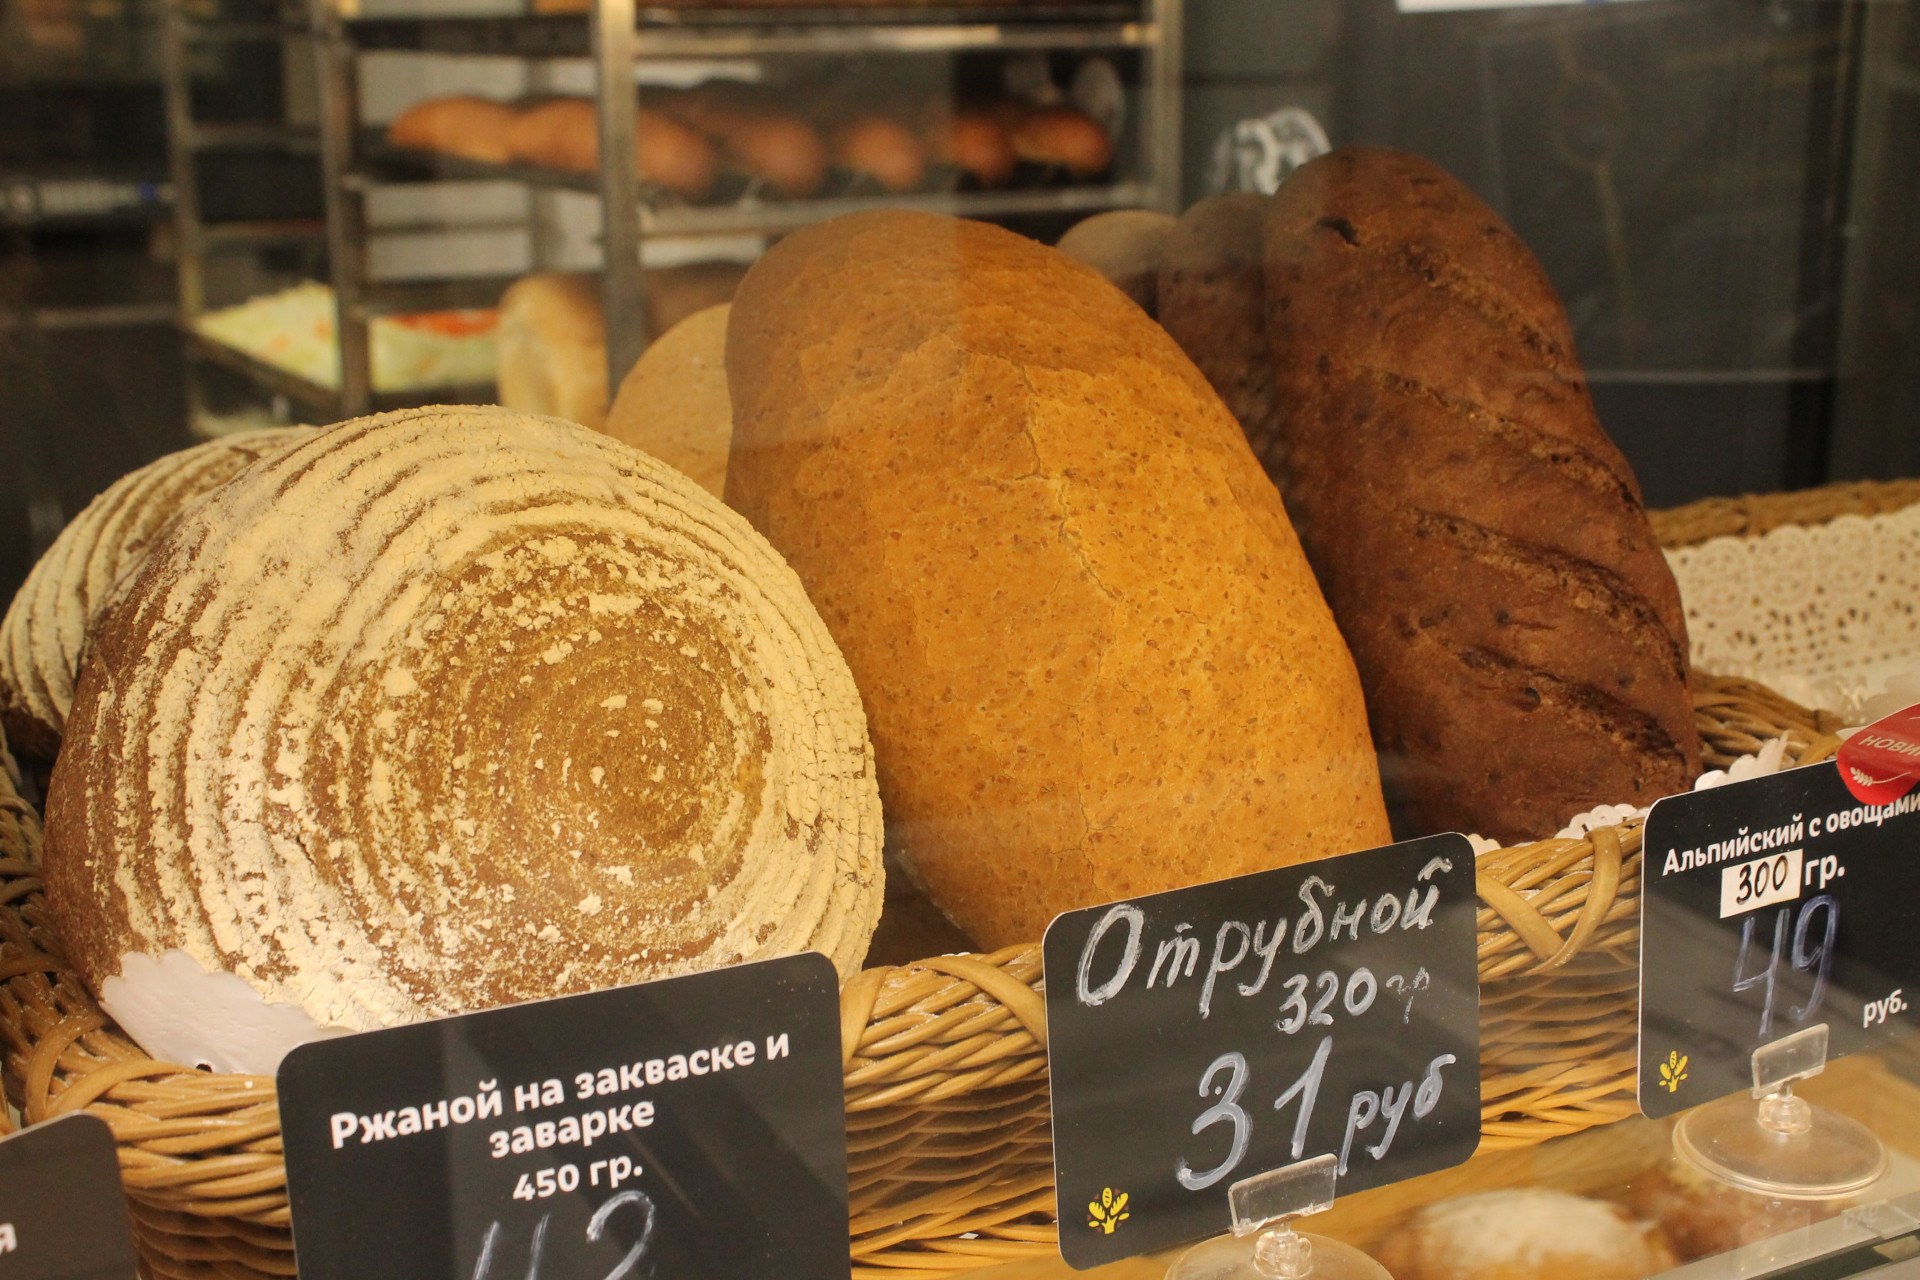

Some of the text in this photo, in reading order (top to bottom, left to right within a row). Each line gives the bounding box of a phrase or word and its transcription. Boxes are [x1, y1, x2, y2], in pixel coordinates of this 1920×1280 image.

[1662, 813, 1804, 876] Альпийский
[1808, 816, 1822, 838] с
[1736, 853, 1846, 905] 300 гр.
[1076, 856, 1453, 1019] Отрубной
[1732, 894, 1840, 1039] 49
[1276, 967, 1377, 1034] 320
[1863, 989, 1908, 1028] руб.
[330, 1032, 790, 1150] Ржаной на закваске и
[1176, 1036, 1456, 1191] 31 руб
[488, 1100, 655, 1159] заварке
[512, 1155, 643, 1201] 450 гр.
